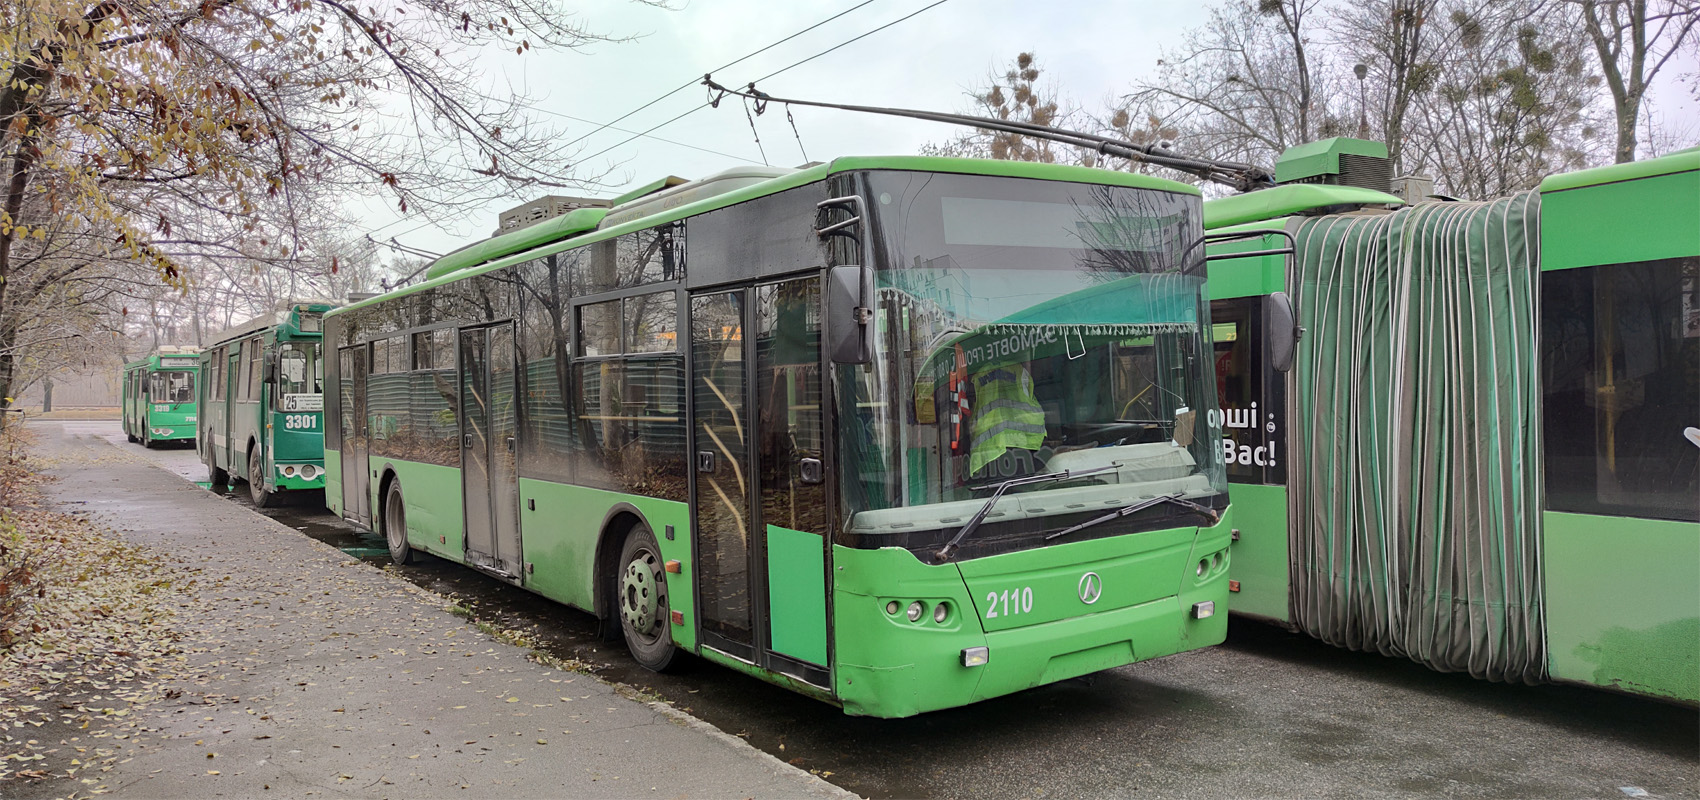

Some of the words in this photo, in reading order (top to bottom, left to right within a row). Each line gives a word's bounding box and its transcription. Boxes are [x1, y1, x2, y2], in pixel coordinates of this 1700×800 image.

[286, 395, 297, 410] 25
[285, 414, 317, 429] 3301
[986, 586, 1033, 619] 2110
